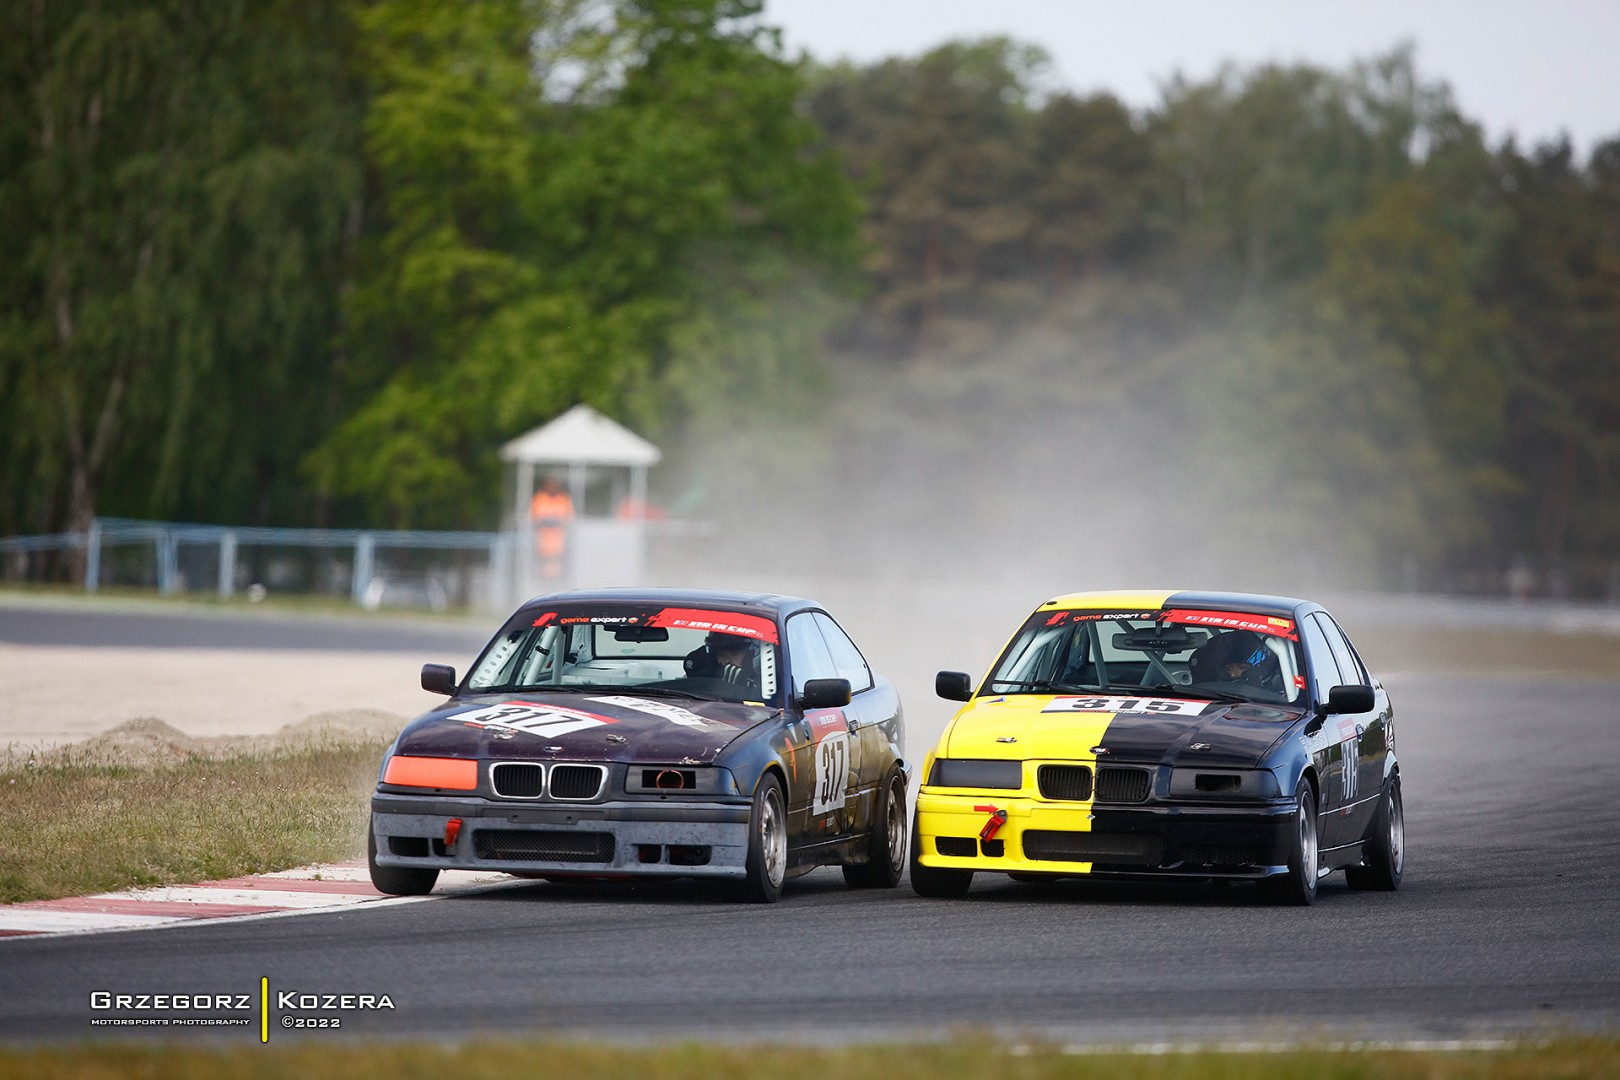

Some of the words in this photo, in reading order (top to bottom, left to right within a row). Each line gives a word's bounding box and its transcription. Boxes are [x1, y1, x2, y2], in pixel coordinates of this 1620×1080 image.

[560, 616, 590, 624] game
[590, 616, 628, 624] expert
[1073, 614, 1102, 622] game
[1102, 613, 1140, 621] expert
[1072, 698, 1186, 712] 315
[474, 707, 584, 728] 317
[820, 740, 845, 806] 317
